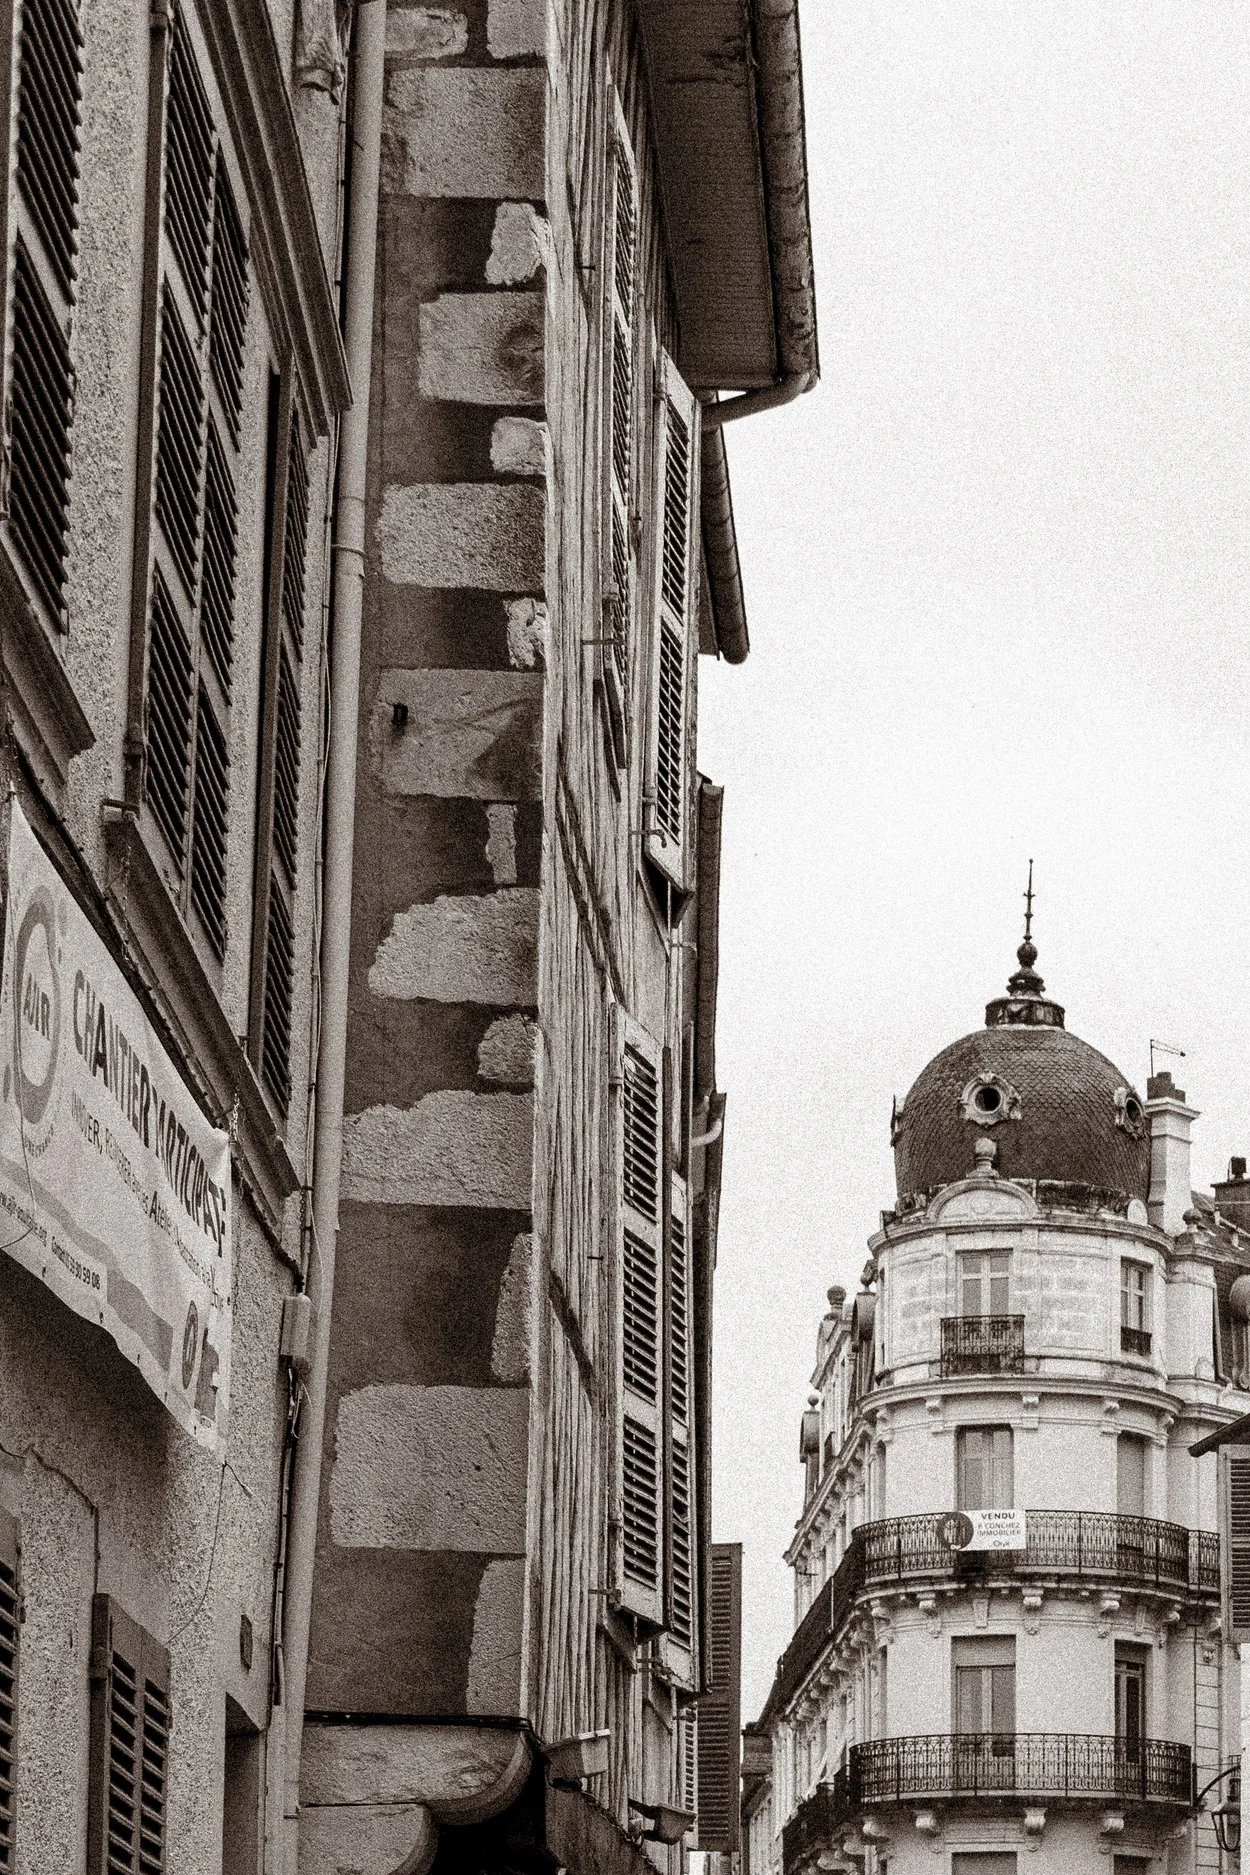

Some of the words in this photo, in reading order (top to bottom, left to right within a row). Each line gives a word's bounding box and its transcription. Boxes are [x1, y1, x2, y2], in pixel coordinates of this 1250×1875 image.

[73, 969, 151, 1148] CHANTIER
[981, 1512, 1016, 1520] VENDU
[977, 1529, 1022, 1537] IMMOBILIER
